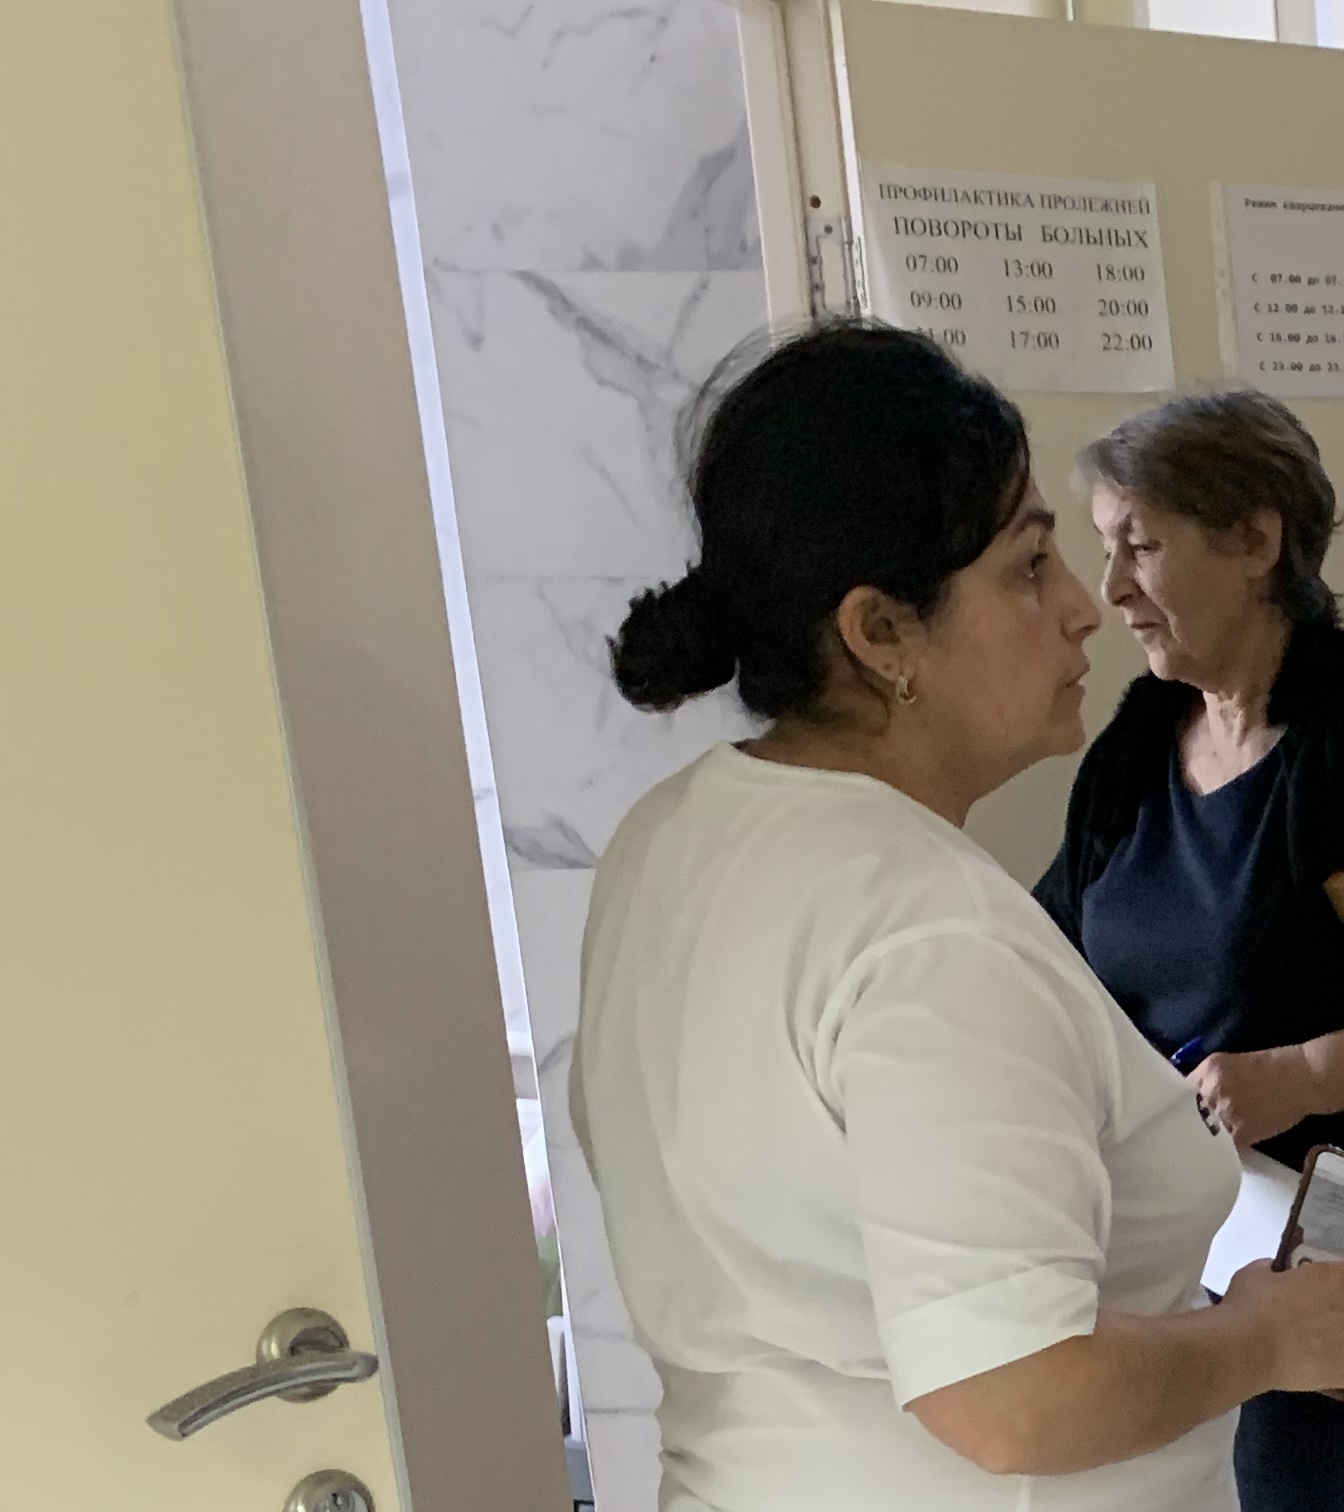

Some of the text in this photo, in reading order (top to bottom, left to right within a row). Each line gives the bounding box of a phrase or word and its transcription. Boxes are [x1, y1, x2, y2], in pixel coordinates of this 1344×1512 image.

[878, 183, 1151, 215] ПРОФИЛАКТИКА ПРОЛЕЖНЕЙ
[893, 216, 1149, 249] ПОВОРОТЫ БОЛЬНЫХ
[905, 254, 1146, 282] 07:00 13:00 18:00
[910, 290, 1149, 317] 09:00 15:00 20:00
[1010, 330, 1060, 350] 17:00
[1102, 332, 1152, 352] 22:00
